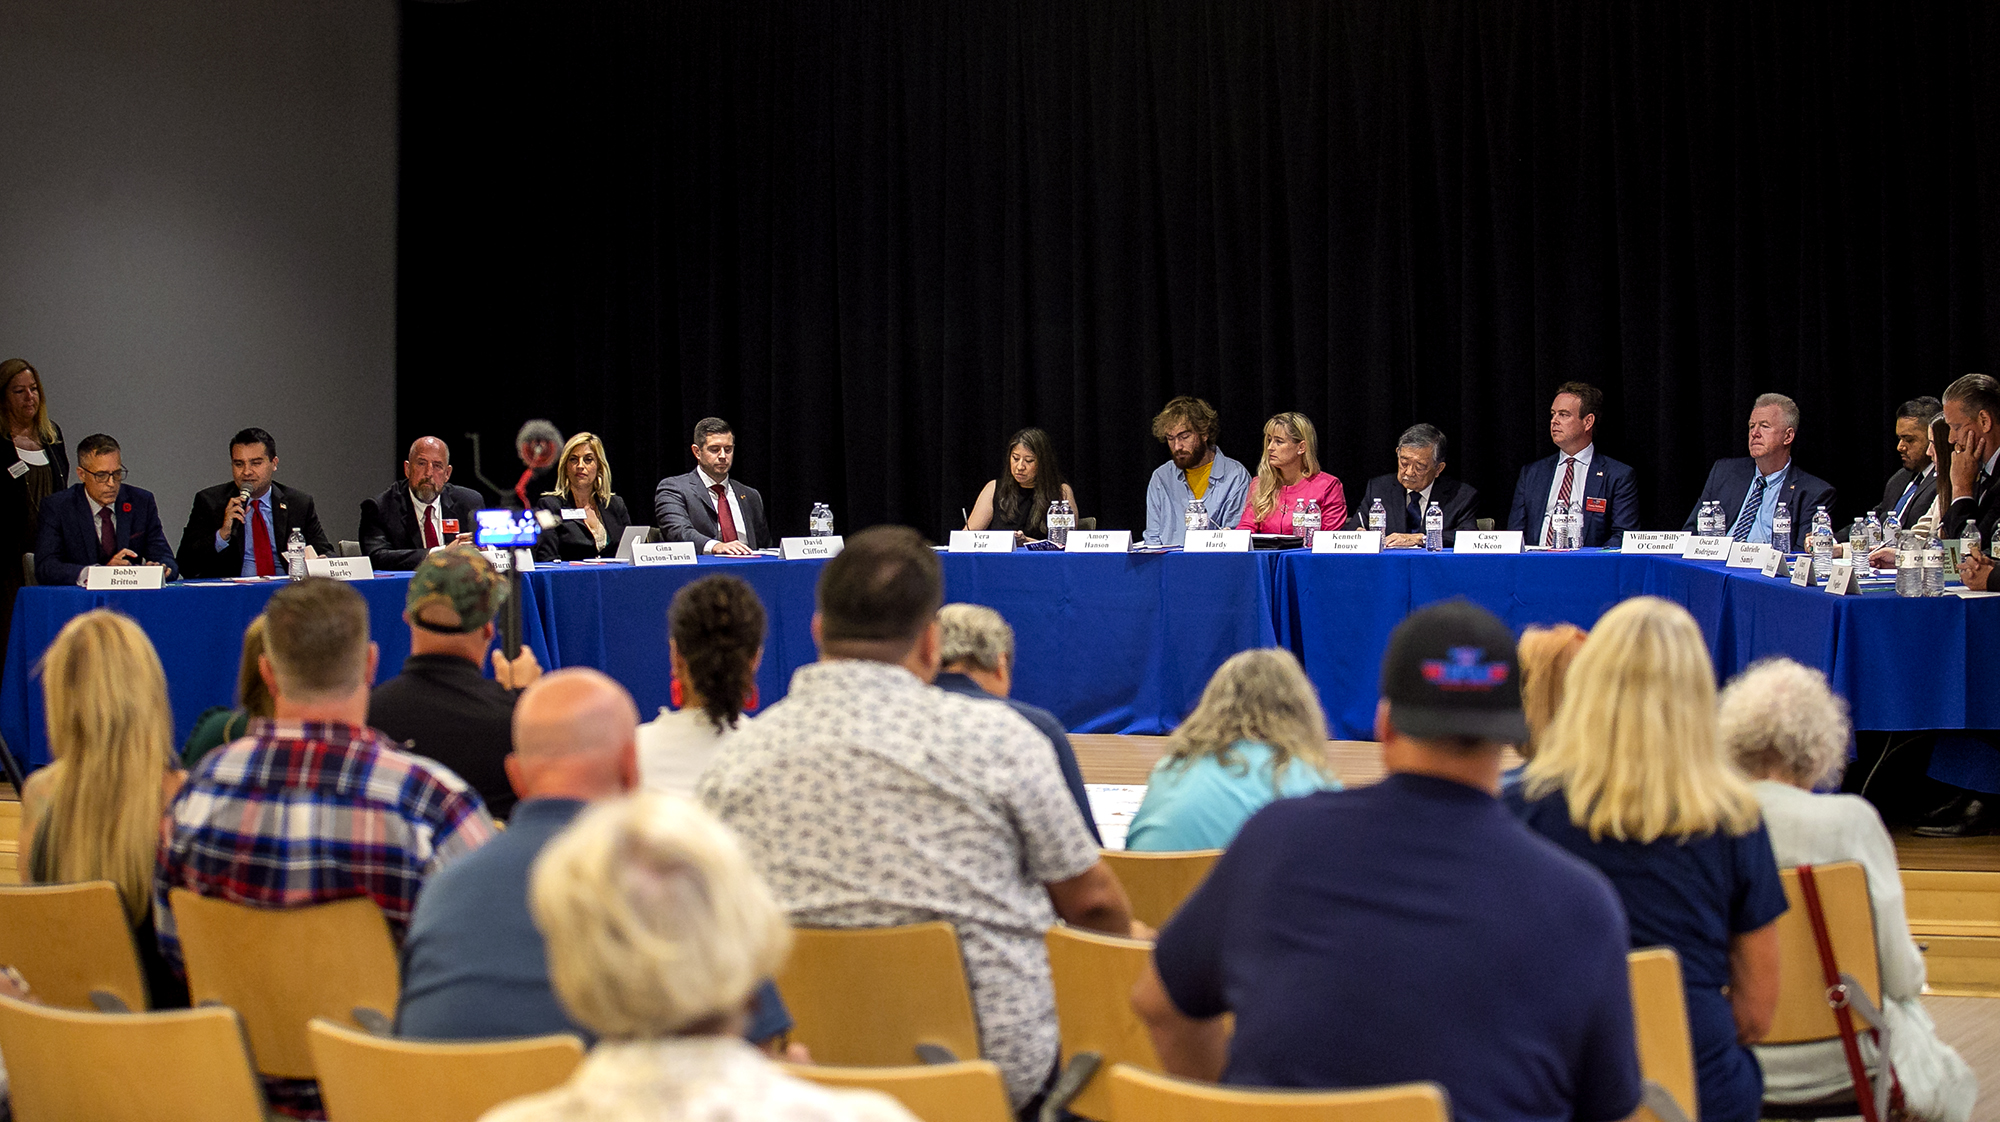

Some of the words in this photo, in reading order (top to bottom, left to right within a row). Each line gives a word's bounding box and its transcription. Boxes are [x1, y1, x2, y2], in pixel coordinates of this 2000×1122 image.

[1086, 533, 1110, 541] Amory
[1478, 533, 1499, 541] Casey
[1630, 533, 1658, 541] William
[973, 541, 988, 549] Fair
[1084, 541, 1110, 549] Hanson
[1206, 541, 1227, 549] Hardy
[1334, 542, 1358, 550] Inouye
[1473, 542, 1502, 550] McKeon
[1699, 538, 1714, 546] Oscar
[655, 544, 673, 552] Gina
[1740, 544, 1761, 553] Gabrielle
[640, 553, 691, 563] Clayton-Tarvin
[113, 568, 138, 577] Bobby
[110, 578, 138, 586] Britton
